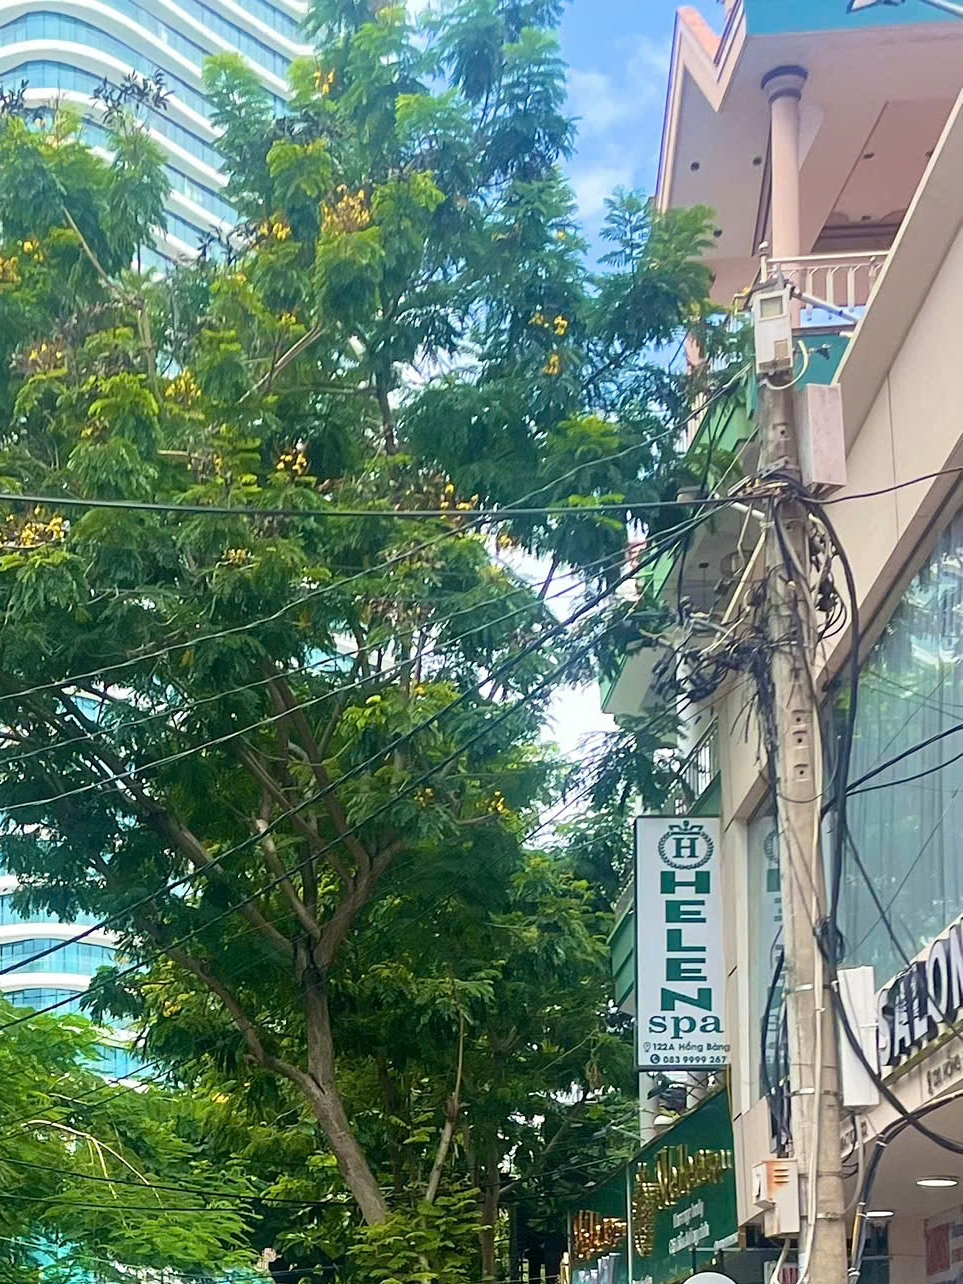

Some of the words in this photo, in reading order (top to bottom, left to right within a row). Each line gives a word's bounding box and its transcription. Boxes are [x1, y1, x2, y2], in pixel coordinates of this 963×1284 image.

[672, 837, 699, 858] H
[660, 870, 712, 1012] HELEN
[648, 1015, 724, 1039] spa
[653, 1043, 675, 1051] 122A
